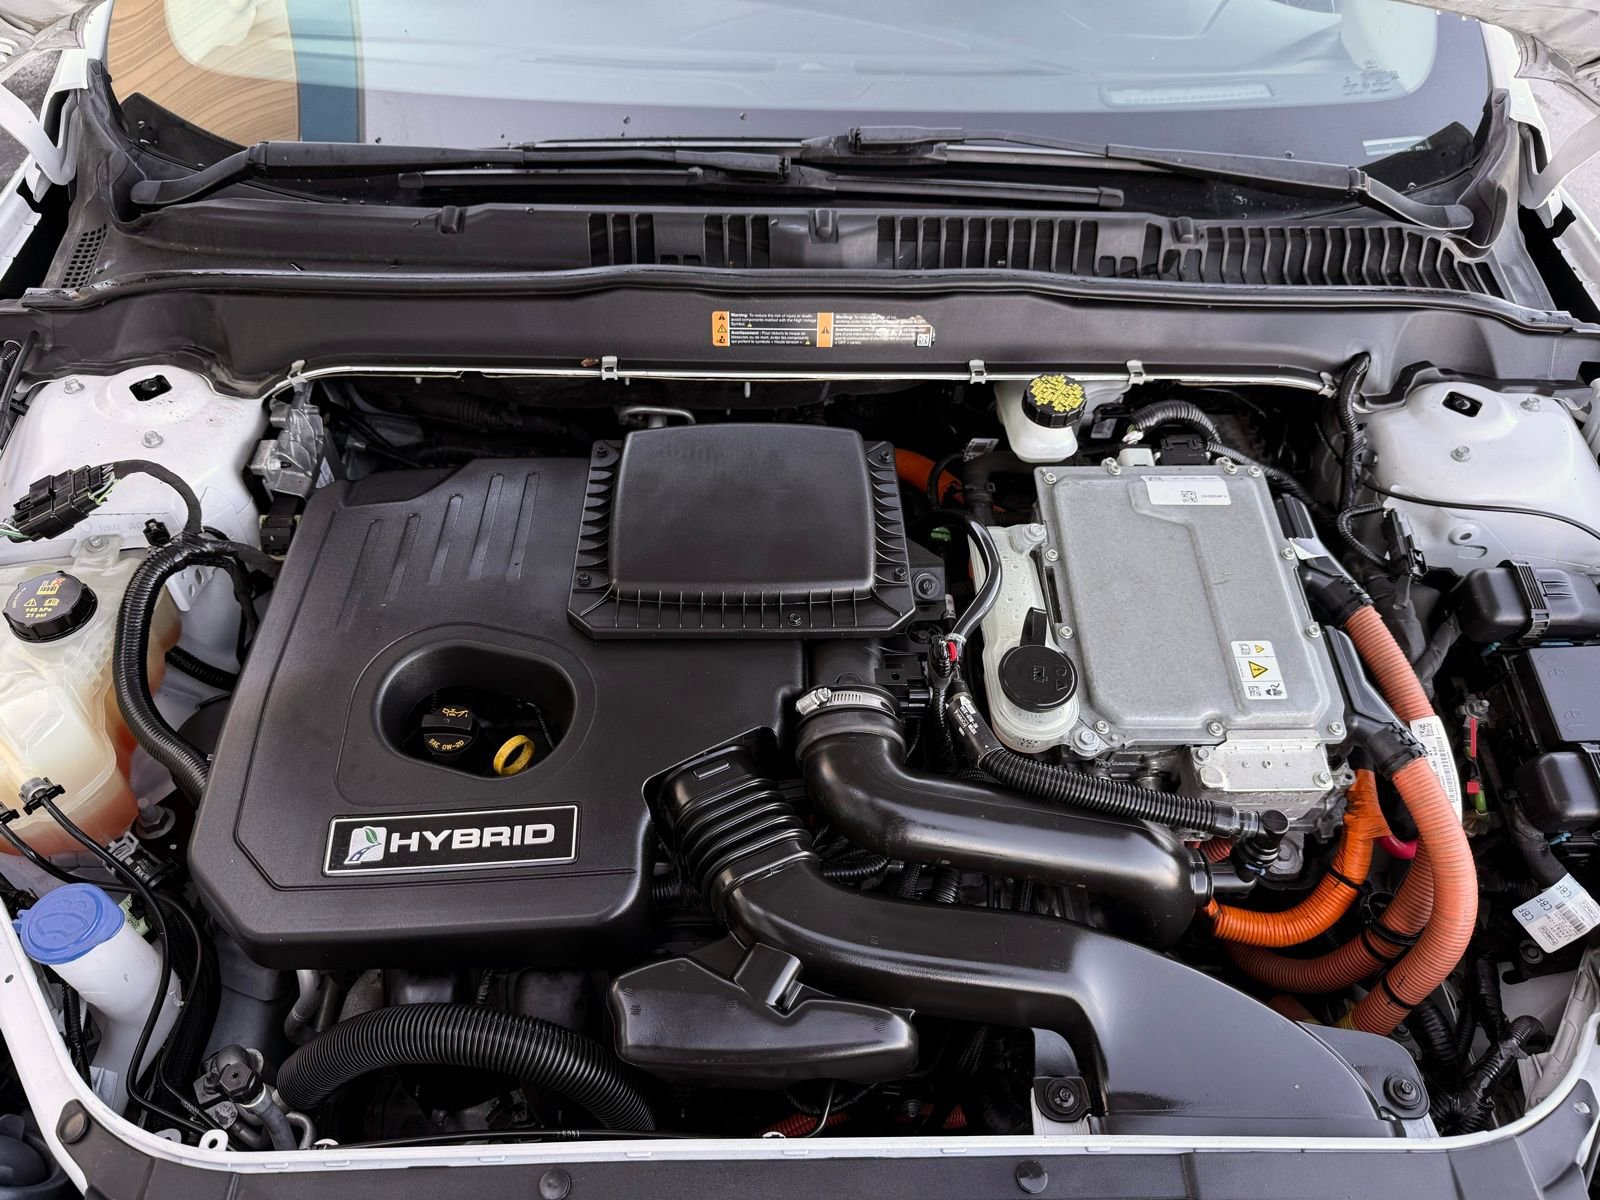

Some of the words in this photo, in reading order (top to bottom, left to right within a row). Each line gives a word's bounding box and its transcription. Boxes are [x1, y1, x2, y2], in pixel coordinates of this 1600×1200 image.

[429, 738, 441, 749] SAE
[389, 823, 556, 853] HYBRID
[1556, 884, 1573, 899] CBF
[1535, 897, 1553, 912] CBF
[1517, 907, 1535, 922] CBF
